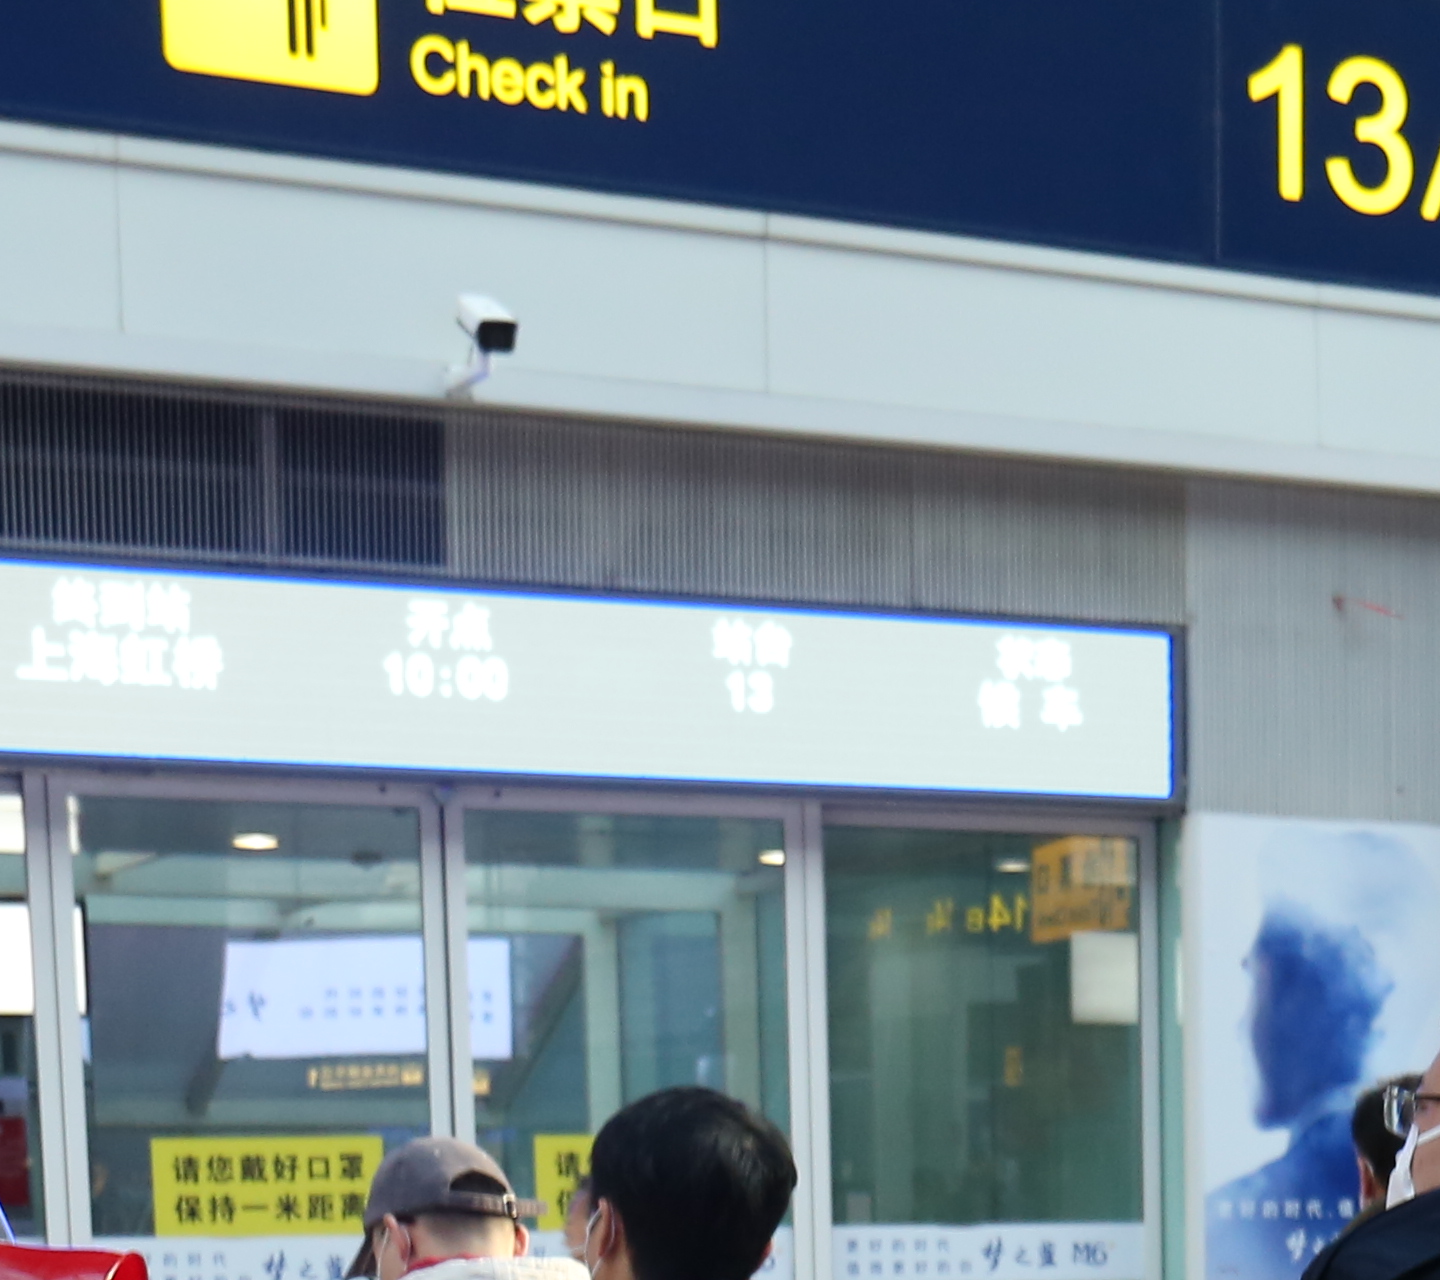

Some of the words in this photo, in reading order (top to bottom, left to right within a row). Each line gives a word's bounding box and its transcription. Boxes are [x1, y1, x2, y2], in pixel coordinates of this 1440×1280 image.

[410, 35, 587, 115] Check
[601, 60, 648, 121] in
[383, 652, 509, 701] 10:00
[174, 1153, 364, 1184] 请您戴好口罩
[174, 1193, 365, 1223] 保持一米距离
